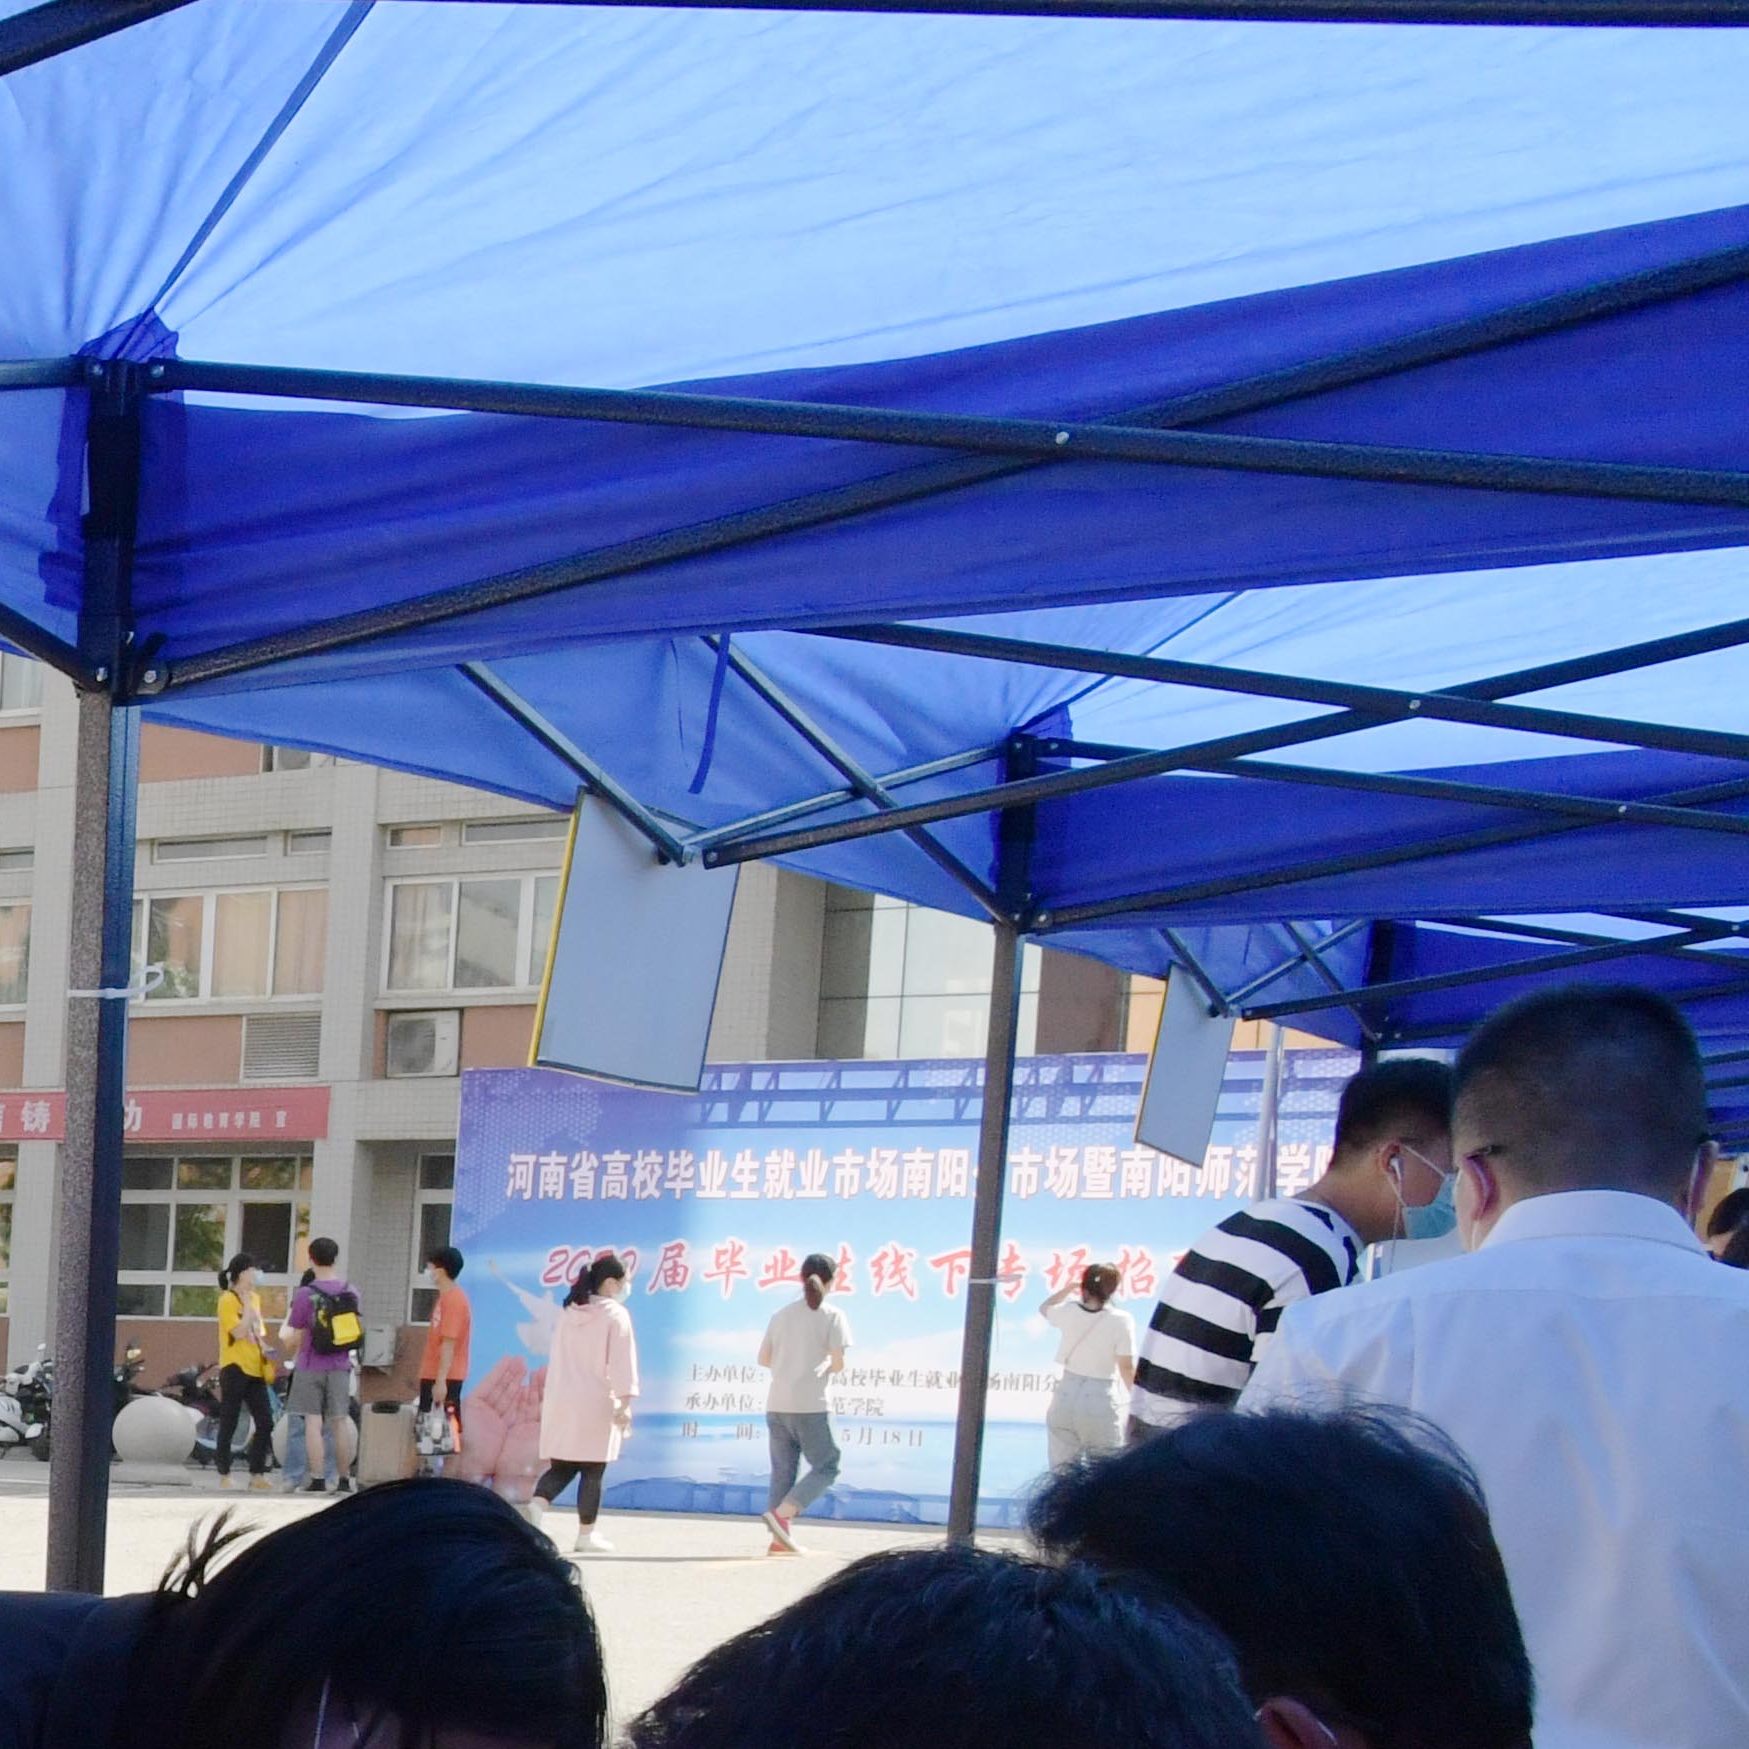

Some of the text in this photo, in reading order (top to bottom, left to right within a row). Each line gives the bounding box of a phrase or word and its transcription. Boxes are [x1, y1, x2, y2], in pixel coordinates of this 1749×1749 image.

[505, 1144, 1335, 1201] 河南省高校毕业生就业市场南阳市场暨南阳师范学
